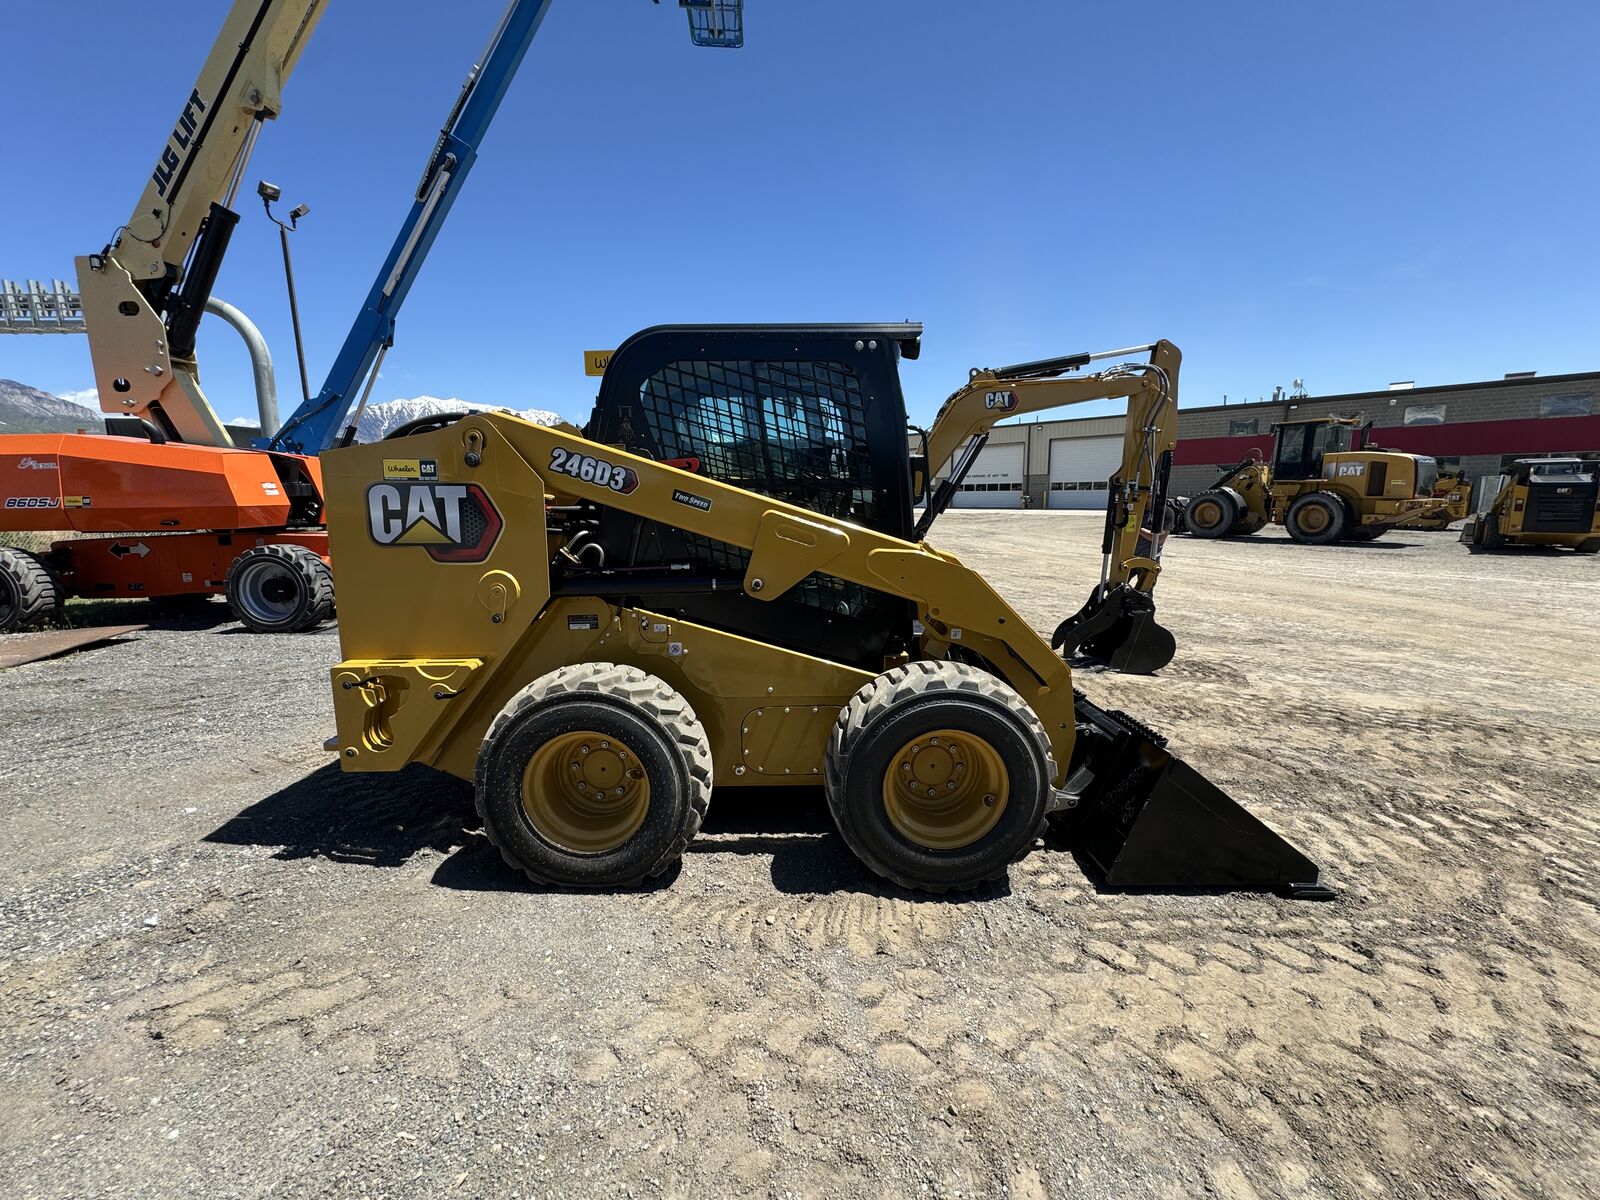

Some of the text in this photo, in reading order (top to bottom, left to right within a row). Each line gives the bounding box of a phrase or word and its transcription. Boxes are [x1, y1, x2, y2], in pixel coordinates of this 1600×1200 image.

[152, 87, 207, 198] JLG LIFT
[985, 391, 1010, 409] CAT
[421, 464, 435, 473] CAT
[549, 447, 627, 491] 246D3
[1339, 465, 1364, 477] CAT
[5, 497, 62, 508] 860SJ
[675, 492, 709, 509] TWO SPEED
[368, 484, 467, 544] CAT
